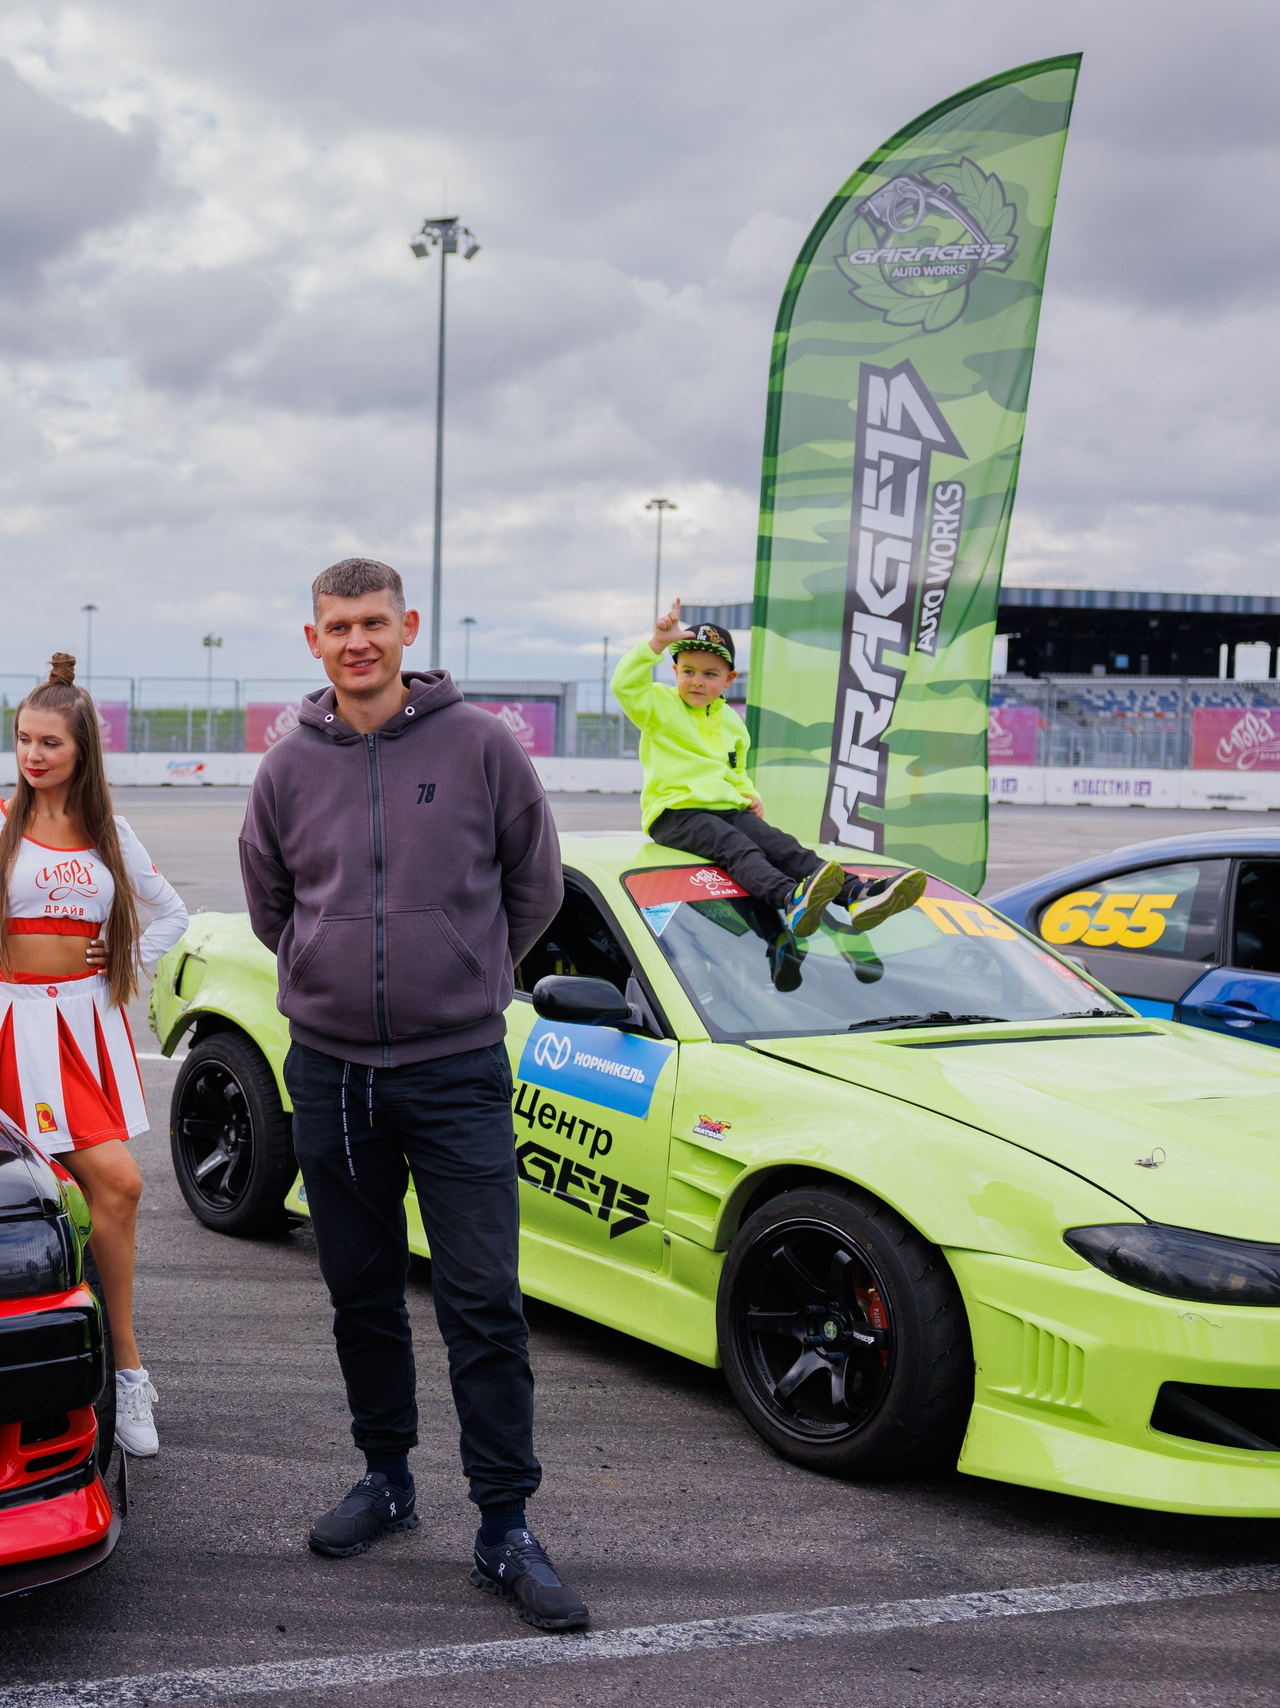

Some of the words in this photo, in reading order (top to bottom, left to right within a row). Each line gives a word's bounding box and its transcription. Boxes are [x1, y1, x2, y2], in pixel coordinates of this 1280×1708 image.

[892, 266, 921, 279] AUTO
[923, 264, 967, 277] WORKS
[926, 484, 963, 585] WORKS
[829, 371, 947, 851] ARAGE13
[919, 588, 945, 653] AUTO
[417, 783, 436, 804] 78
[44, 904, 84, 917] ДРАЙВ
[710, 888, 738, 897] ДРАЙВ
[1040, 891, 1178, 948] 655
[573, 1051, 646, 1084] НОРНИКЕЛЬ
[513, 1082, 613, 1160] Центр
[514, 1134, 651, 1239] GE13
[873, 1308, 882, 1328] NISS
